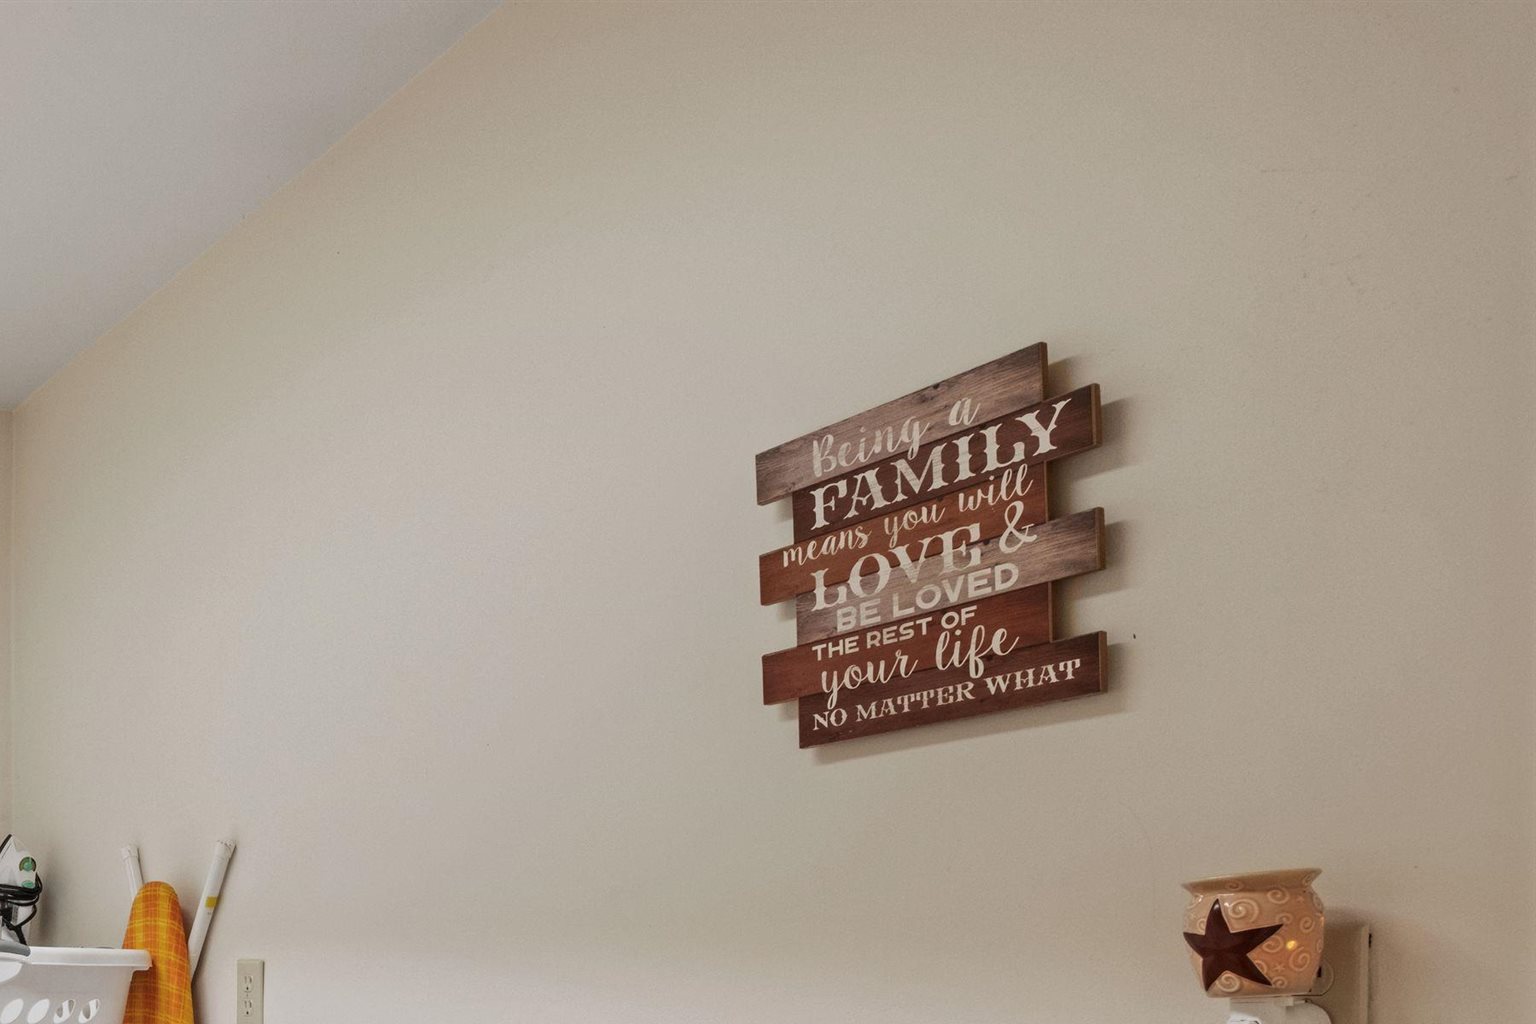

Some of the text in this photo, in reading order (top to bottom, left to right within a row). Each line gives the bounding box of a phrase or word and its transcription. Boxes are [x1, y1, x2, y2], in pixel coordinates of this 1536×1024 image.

[809, 398, 1072, 530] FAMILY
[813, 397, 980, 477] Being a
[782, 463, 1034, 568] means you will
[810, 501, 1037, 612] LOVE &
[812, 605, 978, 661] THE REST OF
[837, 562, 1019, 633] BE LOVED
[812, 658, 1082, 731] NO MATTER WHAT
[821, 624, 1019, 709] your life
